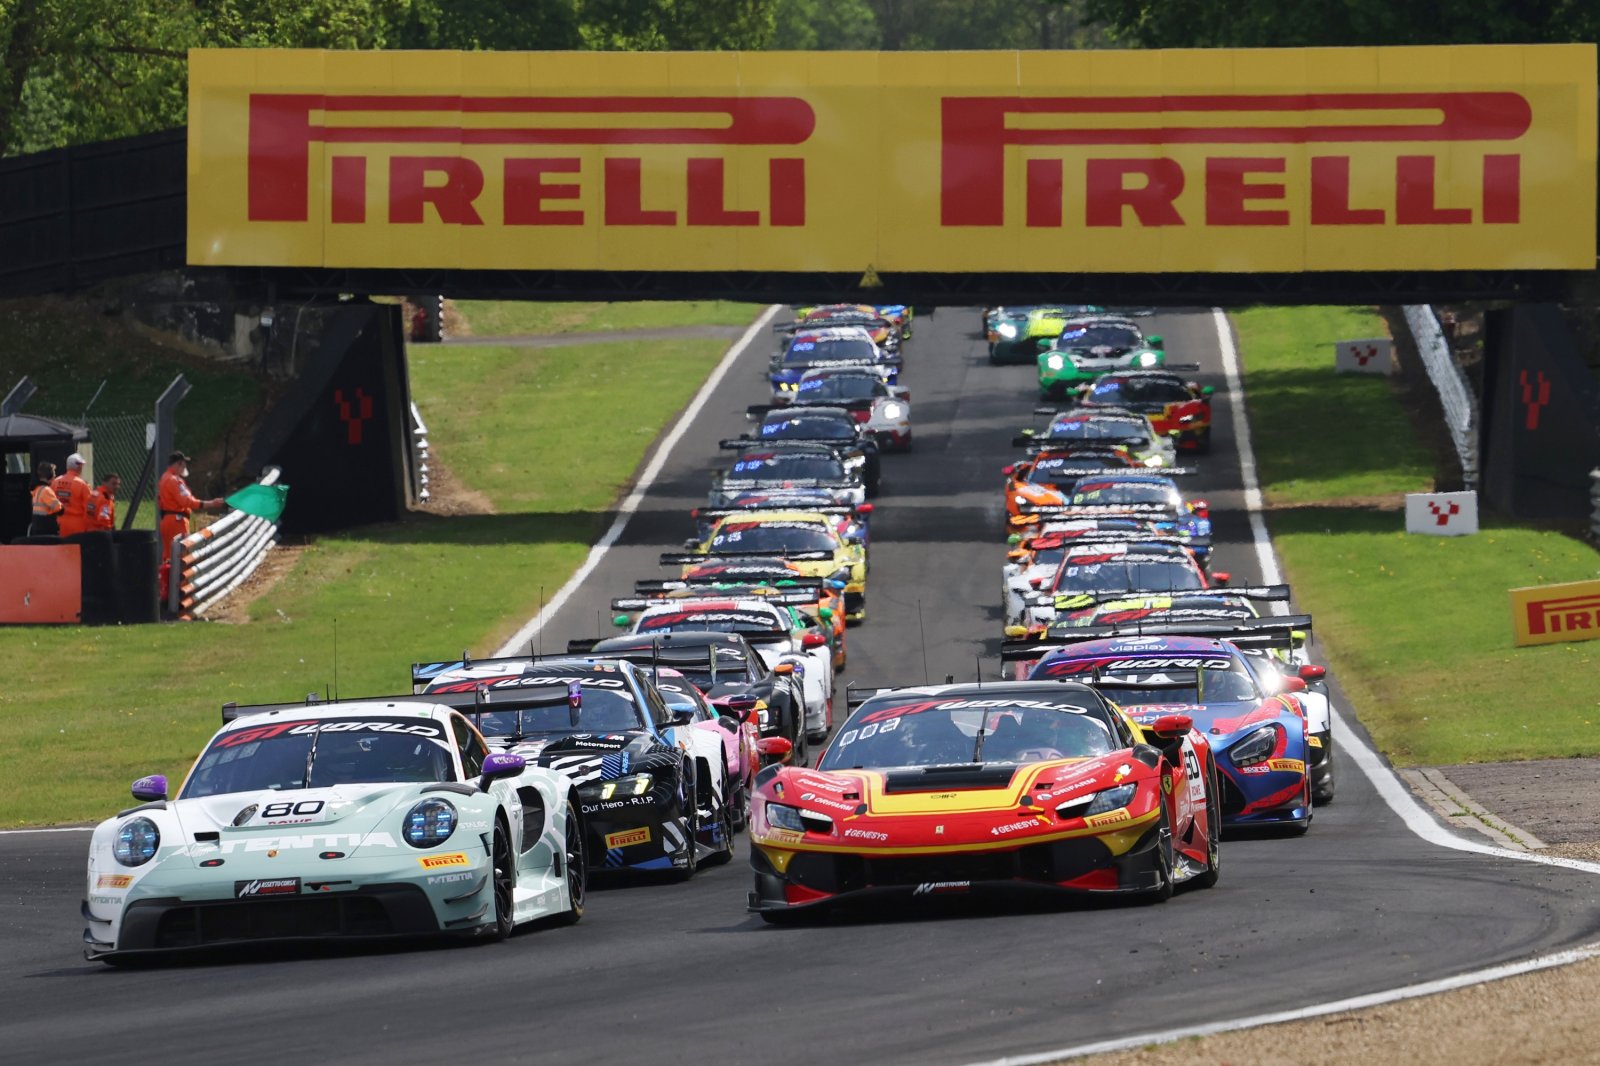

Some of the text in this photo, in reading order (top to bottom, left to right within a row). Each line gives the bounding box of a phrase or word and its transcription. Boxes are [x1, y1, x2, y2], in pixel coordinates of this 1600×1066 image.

[248, 93, 816, 226] PIRELLI
[940, 92, 1532, 227] PIRELLI
[1526, 594, 1600, 635] PIR
[1109, 643, 1169, 652] viaplay
[1046, 658, 1231, 675] GT WORLD
[495, 676, 624, 688] WORLD
[860, 699, 1088, 724] GT WORLD
[213, 720, 440, 748] GT WORLD
[575, 740, 621, 749] Motorsport
[1052, 777, 1097, 796] ORIFARM
[261, 800, 325, 818] 80
[582, 804, 598, 813] Our
[601, 801, 624, 810] Hero
[631, 796, 656, 806] R.I.P.
[814, 797, 854, 811] ORIFARM
[997, 818, 1040, 834] GENESYS
[1091, 811, 1128, 828] PIRELLI
[610, 831, 646, 846] PIRELLI
[850, 829, 888, 841] GENESYS
[423, 854, 465, 867] PIRELLI
